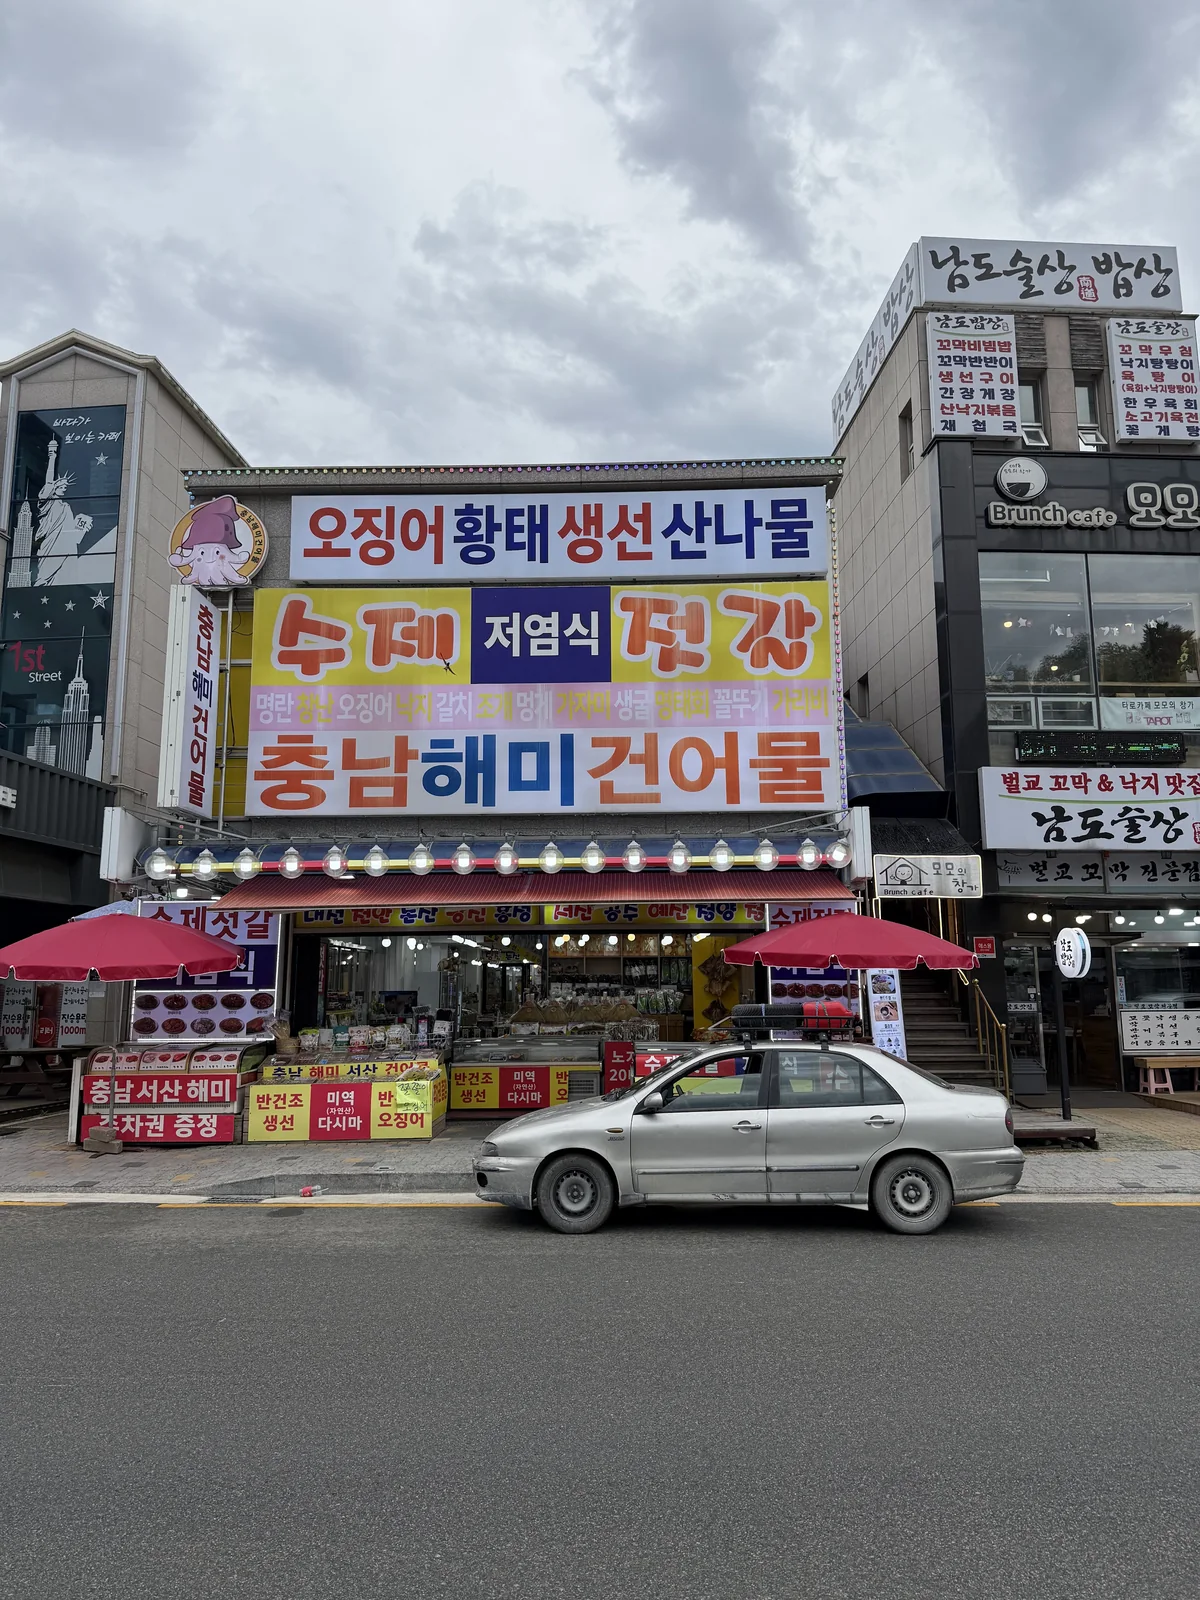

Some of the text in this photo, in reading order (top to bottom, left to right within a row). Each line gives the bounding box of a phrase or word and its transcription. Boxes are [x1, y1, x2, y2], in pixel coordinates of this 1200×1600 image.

[929, 245, 1173, 299] 남도술상 밥상
[935, 314, 1003, 330] 남도밥상
[1116, 320, 1182, 335] 남도술상
[937, 339, 1012, 352] 꼬막비빔밥
[1119, 344, 1192, 357] 꼬막무침
[937, 355, 1013, 368] 꼬막반반이
[1120, 358, 1193, 370] 낙지탕탕이
[939, 371, 1014, 384] 생선구이
[1121, 370, 1195, 383] 육탕이
[939, 387, 1015, 400] 간장게장
[940, 403, 1016, 416] 산낙지볶음
[1123, 397, 1198, 410] 한우육회
[1125, 411, 1199, 423] 소고기육전
[941, 419, 1017, 432] 재첩국
[1126, 424, 1200, 437] 꽃게탕
[991, 503, 1115, 525] Brunch cafe
[303, 499, 813, 566] 오징어 황태 생선 산나물
[276, 596, 458, 678] 수제
[484, 611, 599, 657] 저염식
[8, 641, 45, 672] 1st
[28, 671, 62, 683] Street
[188, 604, 213, 808] 충남 해미 건어물
[256, 692, 294, 724] 명란
[337, 692, 392, 724] 오징어
[396, 692, 432, 723] 낙지
[436, 692, 472, 723] 갈치
[476, 692, 513, 722] 조개
[557, 690, 611, 720] 가자미
[614, 689, 648, 721] 생굴
[655, 689, 709, 719] 명태회
[713, 688, 768, 719] 꼴뚜기
[772, 686, 829, 717] 가리비
[1122, 701, 1151, 710] 타로카페
[1143, 717, 1173, 725] TAROT
[254, 731, 830, 810] 충남 해미 건어물
[1001, 772, 1043, 794] 벌교
[1049, 772, 1092, 795] 꼬막
[1098, 774, 1114, 792] &
[1119, 773, 1160, 795] 낙지
[1031, 805, 1189, 844] 남도술상
[932, 862, 967, 875] 모모의
[952, 878, 979, 893] 창가
[309, 1065, 339, 1078] 해미
[346, 1064, 378, 1077] 서산
[513, 1070, 536, 1083] 미역
[454, 1072, 493, 1086] 반건조
[90, 1079, 230, 1103] 충남 서산 해미
[512, 1083, 536, 1091] (자연산)
[257, 1093, 304, 1110] 반건조
[327, 1091, 354, 1106] 미역
[460, 1089, 486, 1104] 생선
[507, 1091, 542, 1104] 다시마
[326, 1107, 354, 1115] (자연산)
[174, 1115, 217, 1138] 증정
[263, 1115, 295, 1132] 생선
[318, 1116, 362, 1131] 다시마
[377, 1112, 424, 1128] 오징어
